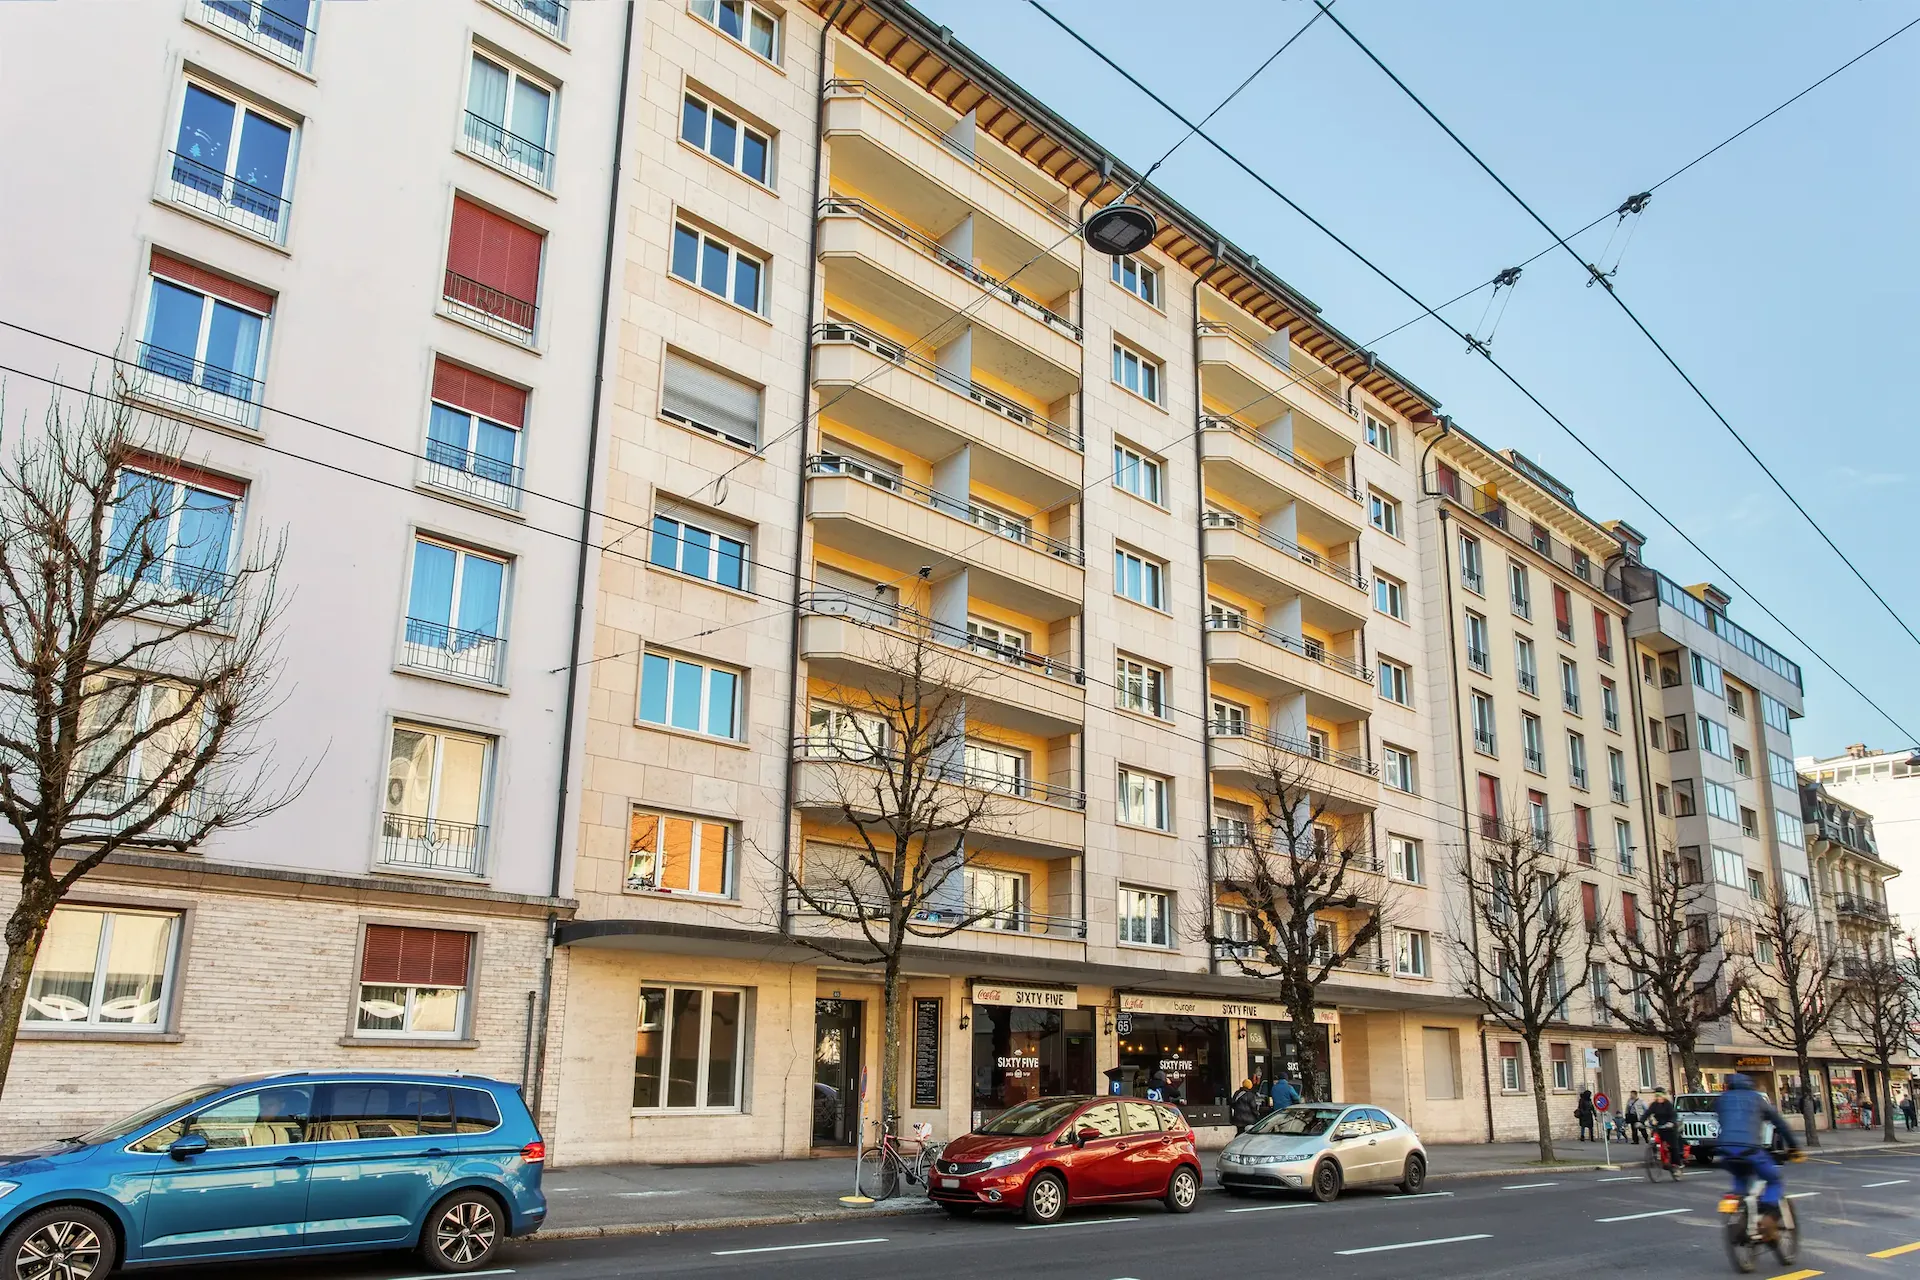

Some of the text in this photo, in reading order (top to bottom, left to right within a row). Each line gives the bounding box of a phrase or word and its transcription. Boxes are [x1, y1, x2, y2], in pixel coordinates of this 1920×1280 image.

[1016, 991, 1064, 1006] SIXTY FIVE
[1174, 1001, 1196, 1013] burger
[1222, 1004, 1257, 1017] SIXTY FIVE
[1117, 1020, 1129, 1032] 65
[1249, 1032, 1263, 1043] 65a
[997, 1056, 1039, 1068] SIXTY FIVE
[1159, 1060, 1193, 1070] SIXTY FIVE
[1113, 1082, 1120, 1093] P
